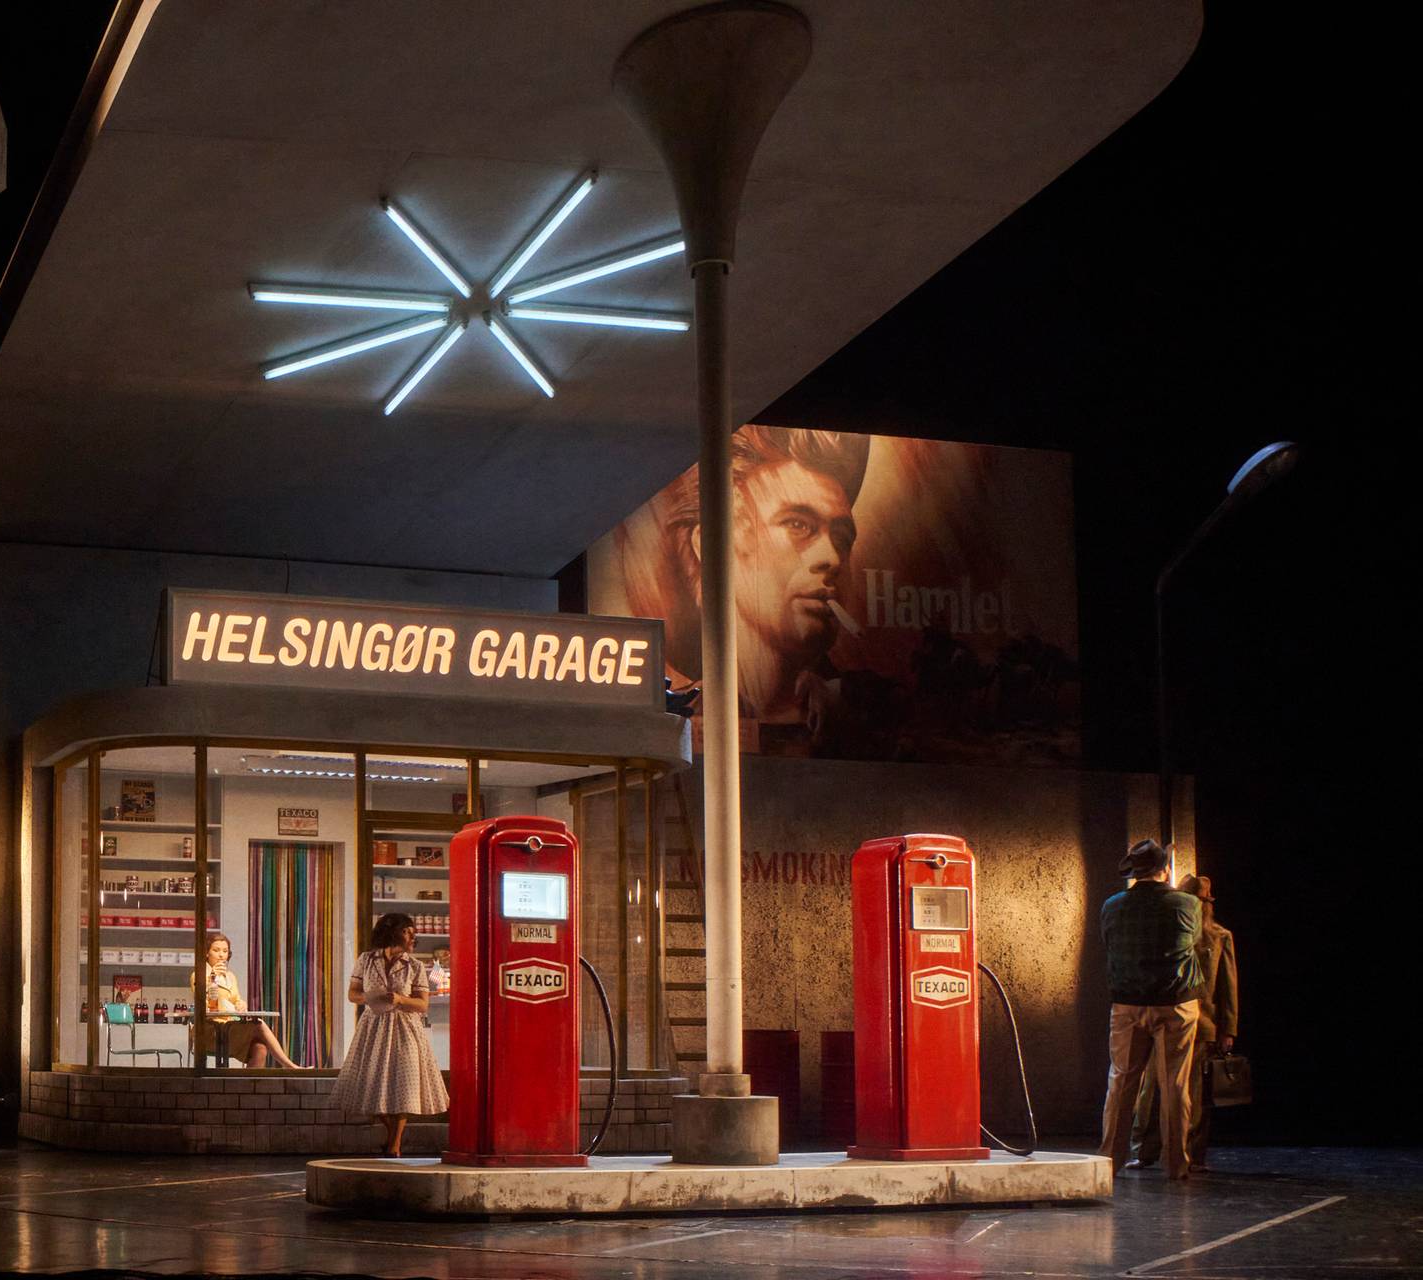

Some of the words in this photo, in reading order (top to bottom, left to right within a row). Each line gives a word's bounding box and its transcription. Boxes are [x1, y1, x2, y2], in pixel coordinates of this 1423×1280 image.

[863, 567, 1019, 635] Hamlet
[181, 612, 455, 674] HELSINGØR
[468, 629, 649, 685] GARAGE
[280, 808, 318, 818] TEXACO
[517, 927, 553, 939] NORMAL
[925, 937, 957, 949] NORMAL
[505, 973, 563, 987] TEXACO
[916, 980, 966, 993] TEXACO
